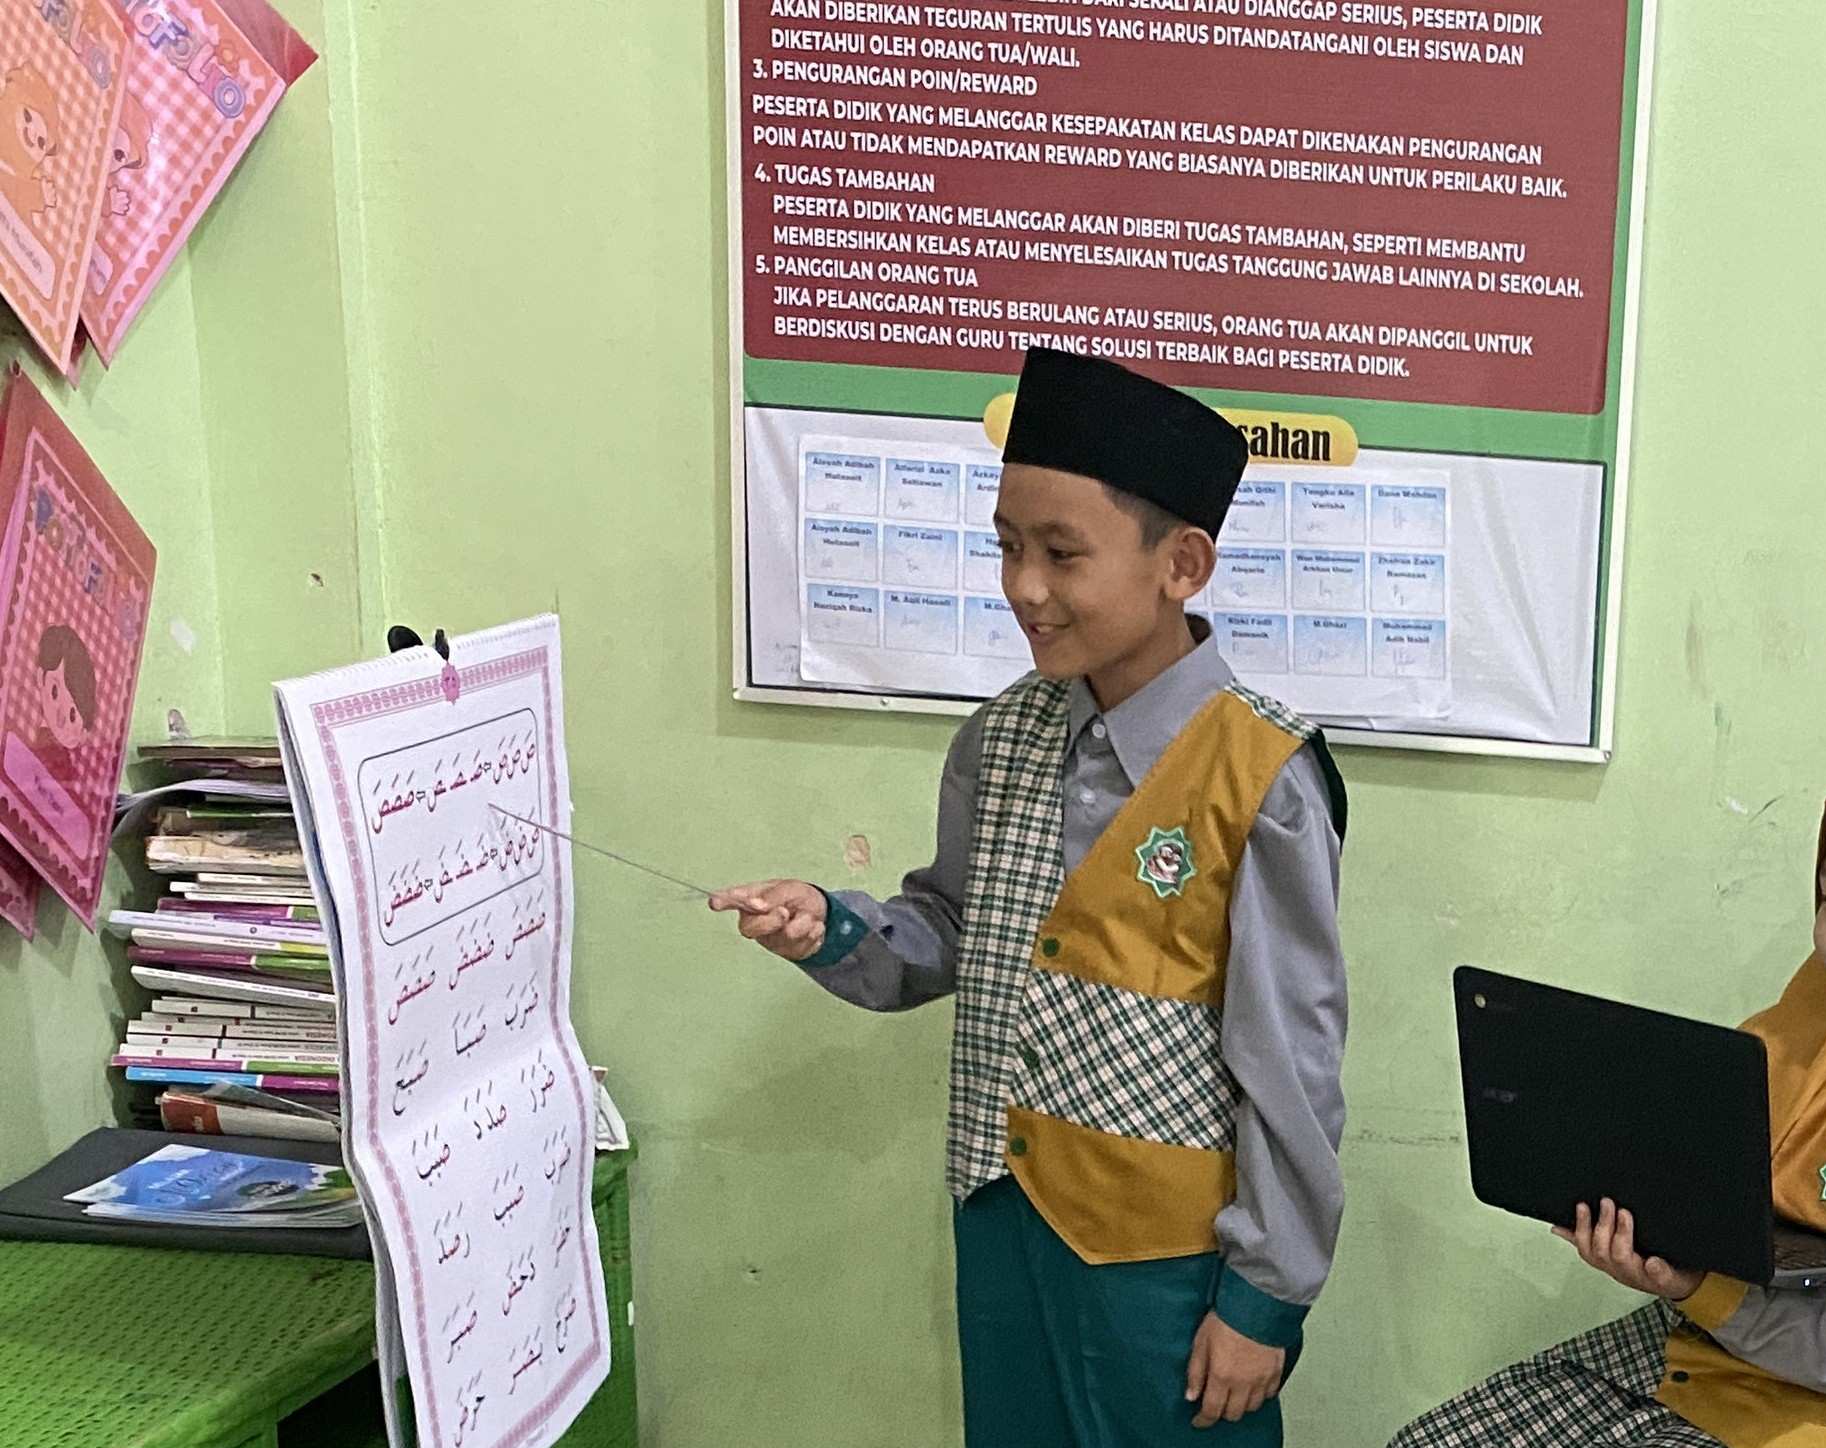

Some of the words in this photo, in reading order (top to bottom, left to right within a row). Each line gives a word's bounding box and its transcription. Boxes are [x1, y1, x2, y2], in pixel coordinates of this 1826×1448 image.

[771, 0, 819, 18] AKAN
[826, 0, 919, 25] DIBERIKAN
[924, 7, 1007, 31] TEGURAN
[1011, 13, 1092, 36] TERTULIS
[1096, 18, 1144, 40] YANG
[1150, 22, 1208, 44] HARUS
[1214, 26, 1368, 54] DITANDATANGANI
[1374, 37, 1419, 58] OLEH
[1424, 40, 1481, 62] SISWA
[1486, 44, 1523, 65] DAN
[1193, 0, 1239, 14] ATAU
[1245, 0, 1337, 20] DIANGGAP
[1342, 3, 1407, 28] SERIUS,
[1413, 8, 1489, 31] PESERTA
[1494, 13, 1542, 34] DIDIK
[753, 59, 767, 78] 3.
[773, 60, 905, 87] PENGURANGAN
[911, 69, 1037, 95] POIN/REWARD
[772, 29, 864, 53] DIKETAHUI
[870, 35, 915, 56] OLEH
[921, 39, 983, 61] ORANG
[988, 42, 1080, 67] TUA/WALI.
[753, 95, 829, 118] PESERTA
[834, 100, 882, 121] DIDIK
[886, 103, 933, 124] YANG
[939, 106, 1047, 132] MELANGGAR
[1052, 114, 1175, 140] KESEPAKATAN
[1181, 122, 1235, 144] KELAS
[1240, 126, 1298, 148] DAPAT
[1303, 130, 1403, 155] DIKENAKAN
[1409, 138, 1541, 165] PENGURANGAN
[754, 126, 796, 146] POIN
[801, 129, 846, 149] ATAU
[851, 132, 903, 153] TIDAK
[908, 136, 1039, 162] MENDAPATKAN
[1046, 145, 1121, 167] REWARD
[1126, 150, 1173, 171] YANG
[1179, 153, 1266, 177] BIASANYA
[1271, 159, 1363, 184] DIBERIKAN
[1369, 166, 1427, 188] UNTUK
[1433, 170, 1516, 194] PERILAKU
[1522, 176, 1566, 197] BAIK.
[755, 163, 770, 181] 4.
[775, 165, 832, 186] TUGAS
[836, 168, 934, 192] TAMBAHAN
[774, 195, 849, 217] PESERTA
[854, 200, 902, 221] DIDIK
[906, 204, 953, 224] YANG
[958, 207, 1065, 232] MELANGGAR
[1070, 215, 1118, 234] AKAN
[1123, 218, 1180, 239] DIBERI
[1184, 222, 1241, 243] TUGAS
[1246, 226, 1348, 254] TAMBAHAN,
[1353, 233, 1421, 255] SEPERTI
[1427, 238, 1525, 263] MEMBANTU
[756, 255, 769, 273] 5.
[775, 256, 873, 280] PANGGILAN
[878, 263, 939, 284] ORANG
[944, 267, 978, 287] TUA
[774, 226, 911, 252] MEMBERSIHKAN
[917, 235, 970, 256] KELAS
[975, 239, 1020, 259] ATAU
[1025, 242, 1167, 268] MENYELESAIKAN
[1172, 251, 1228, 273] TUGAS
[1232, 255, 1327, 280] TANGGUNG
[1332, 262, 1394, 284] JAWAB
[1399, 267, 1473, 289] LAINNYA
[1478, 272, 1495, 291] DI
[1500, 274, 1583, 297] SEKOLAH.
[774, 286, 811, 306] JIKA
[817, 289, 943, 315] PELANGGARAN
[949, 297, 1002, 318] TERUS
[1008, 302, 1099, 325] BERULANG
[1104, 308, 1148, 328] ATAU
[1153, 311, 1217, 336] SERIUS,
[1222, 316, 1283, 337] ORANG
[1288, 320, 1321, 340] TUA
[1325, 323, 1374, 344] AKAN
[1379, 327, 1470, 350] DIPANGGIL
[1475, 333, 1533, 355] UNTUK
[775, 317, 874, 340] BERDISKUSI
[880, 324, 951, 345] DENGAN
[956, 328, 1003, 349] GURU
[1008, 332, 1087, 354] TENTANG
[1092, 337, 1151, 359] SOLUSI
[1156, 341, 1229, 364] TERBAIK
[1234, 347, 1273, 367] BAGI
[1279, 350, 1354, 372] PESERTA
[1358, 355, 1409, 376] DIDIK.
[1237, 421, 1330, 461] ahan
